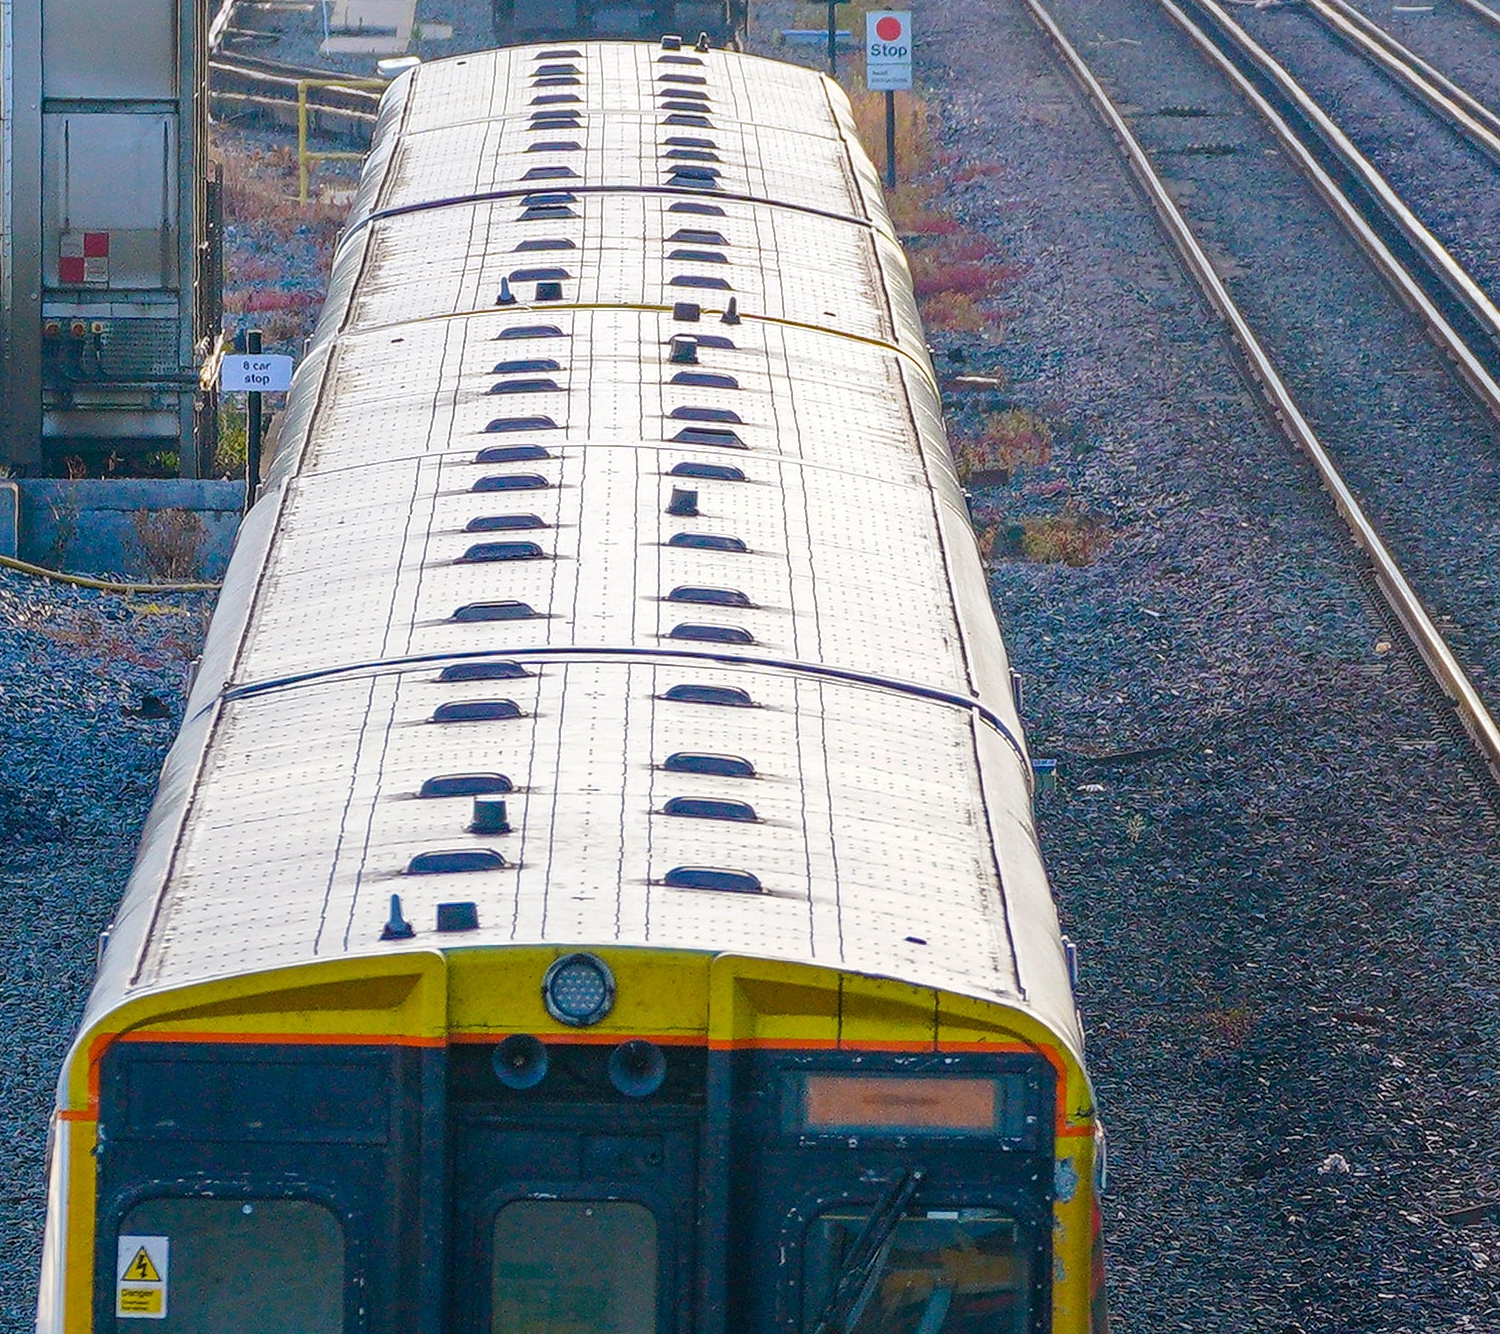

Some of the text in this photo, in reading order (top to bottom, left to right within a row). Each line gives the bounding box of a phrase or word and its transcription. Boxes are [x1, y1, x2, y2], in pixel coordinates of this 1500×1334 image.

[871, 44, 908, 58] Stop
[252, 362, 271, 371] car
[243, 373, 270, 386] stop
